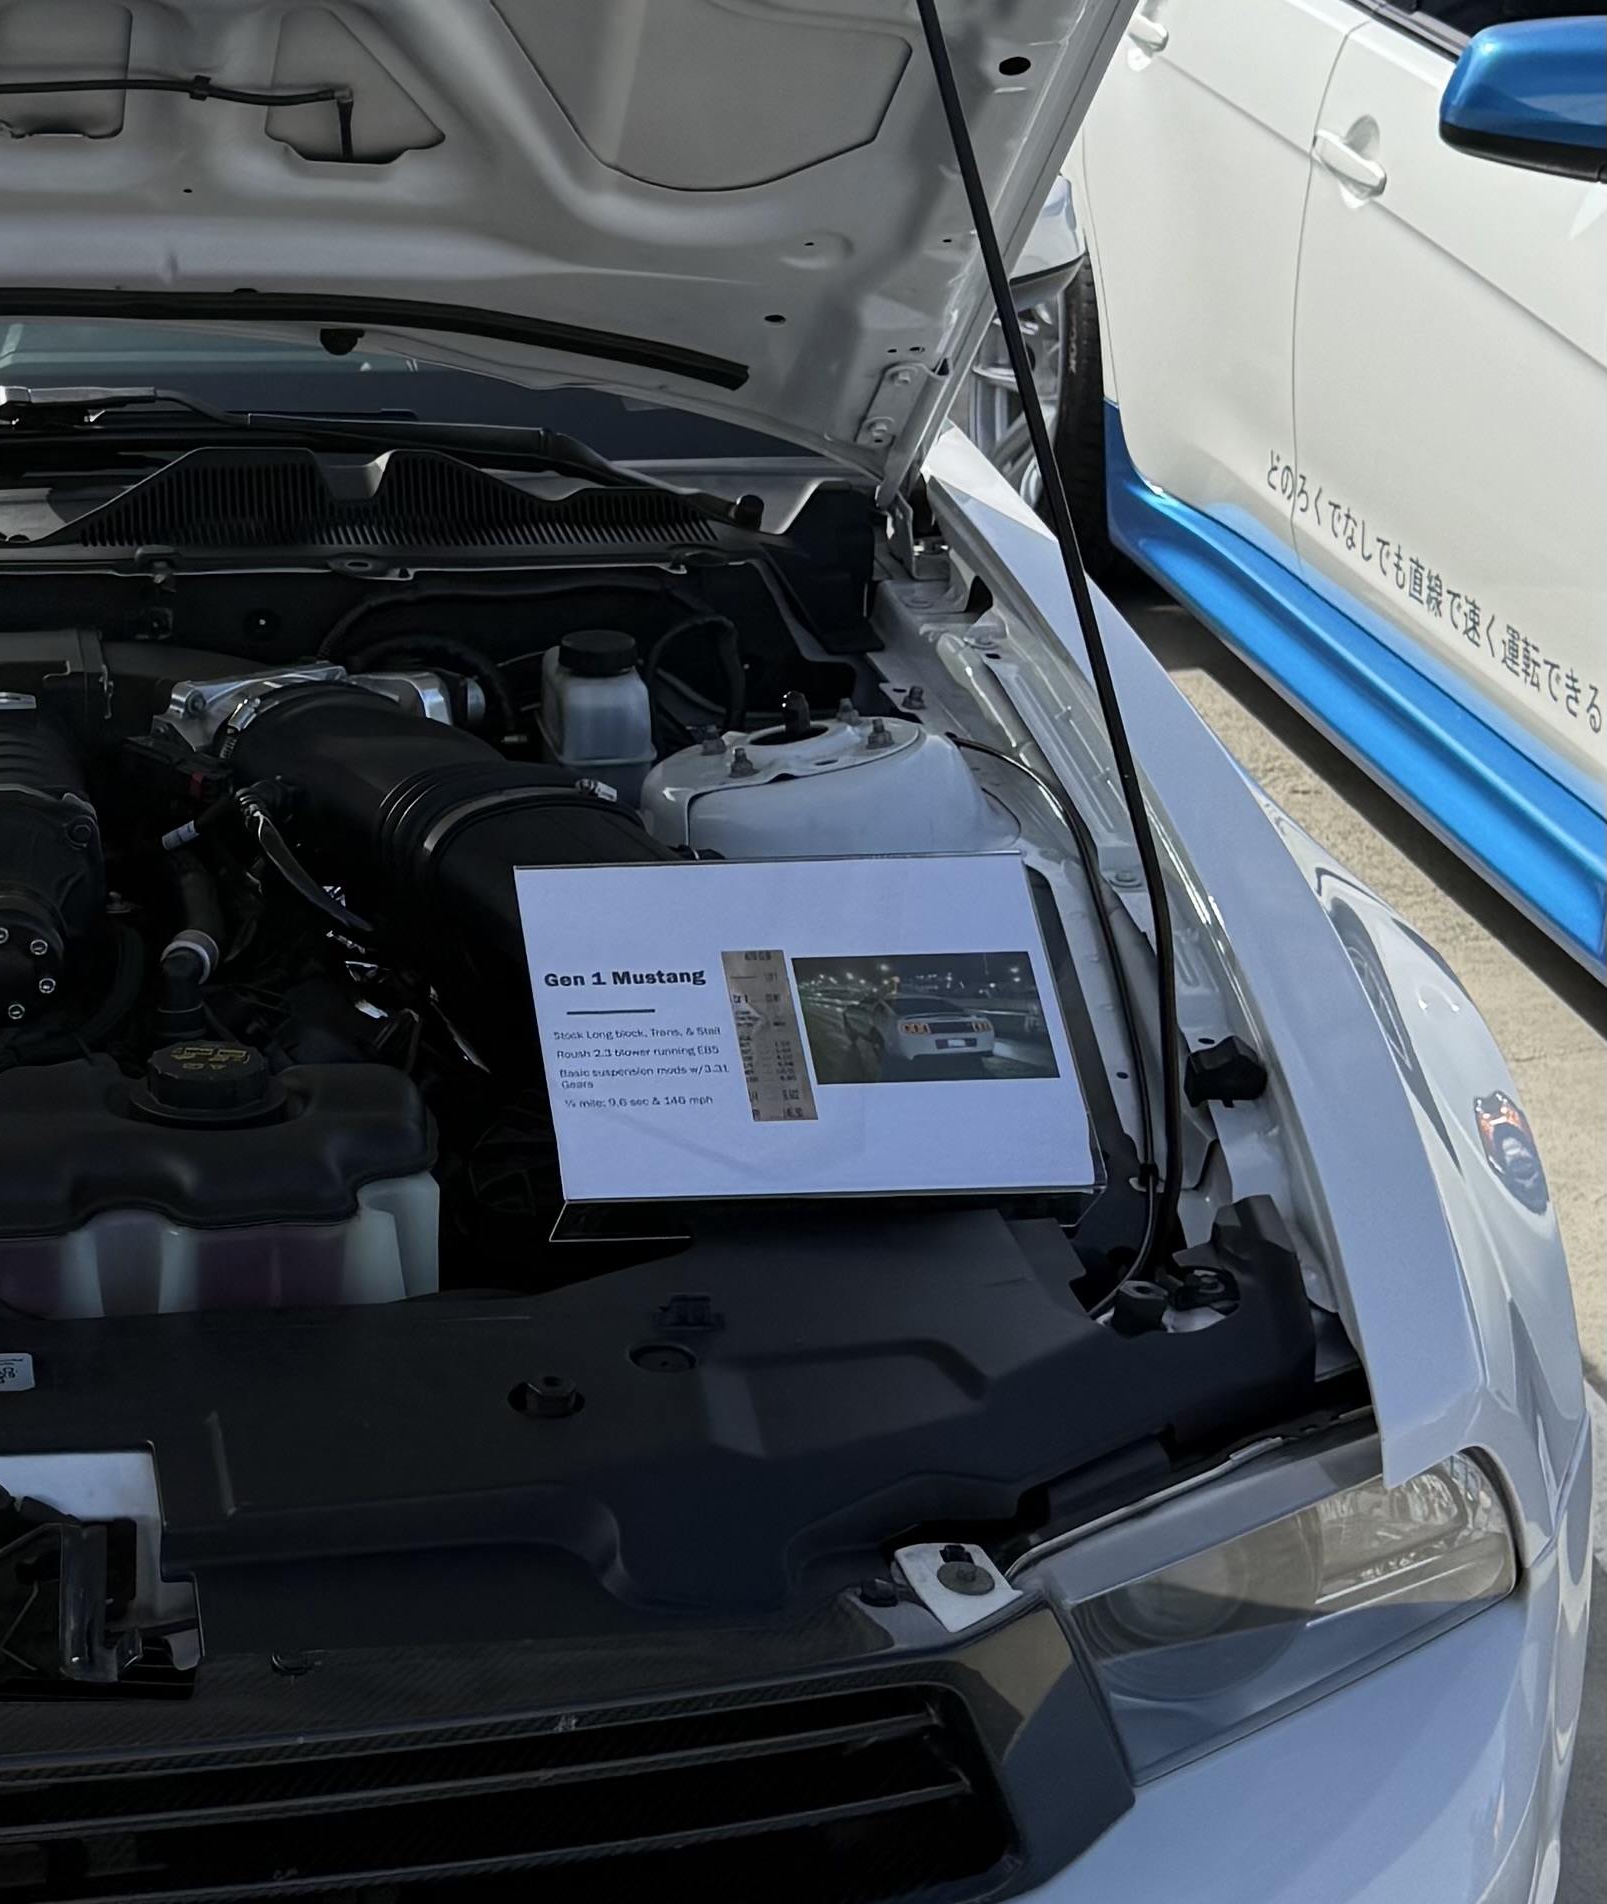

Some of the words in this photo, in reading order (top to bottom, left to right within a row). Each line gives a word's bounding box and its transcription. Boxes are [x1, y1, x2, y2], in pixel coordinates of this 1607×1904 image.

[1266, 449, 1602, 734] どのろくでなしでも直線で速く運転できる
[544, 973, 586, 987] Gen
[591, 971, 607, 986] 1
[612, 970, 707, 986] Mustang
[553, 1031, 584, 1040] Stock
[586, 1030, 614, 1040] Long
[686, 1027, 694, 1036] &
[556, 1050, 591, 1059] Roush
[653, 1046, 696, 1056] running
[592, 1067, 654, 1078] suspension
[652, 1096, 661, 1105] &
[689, 1095, 714, 1105] mph
